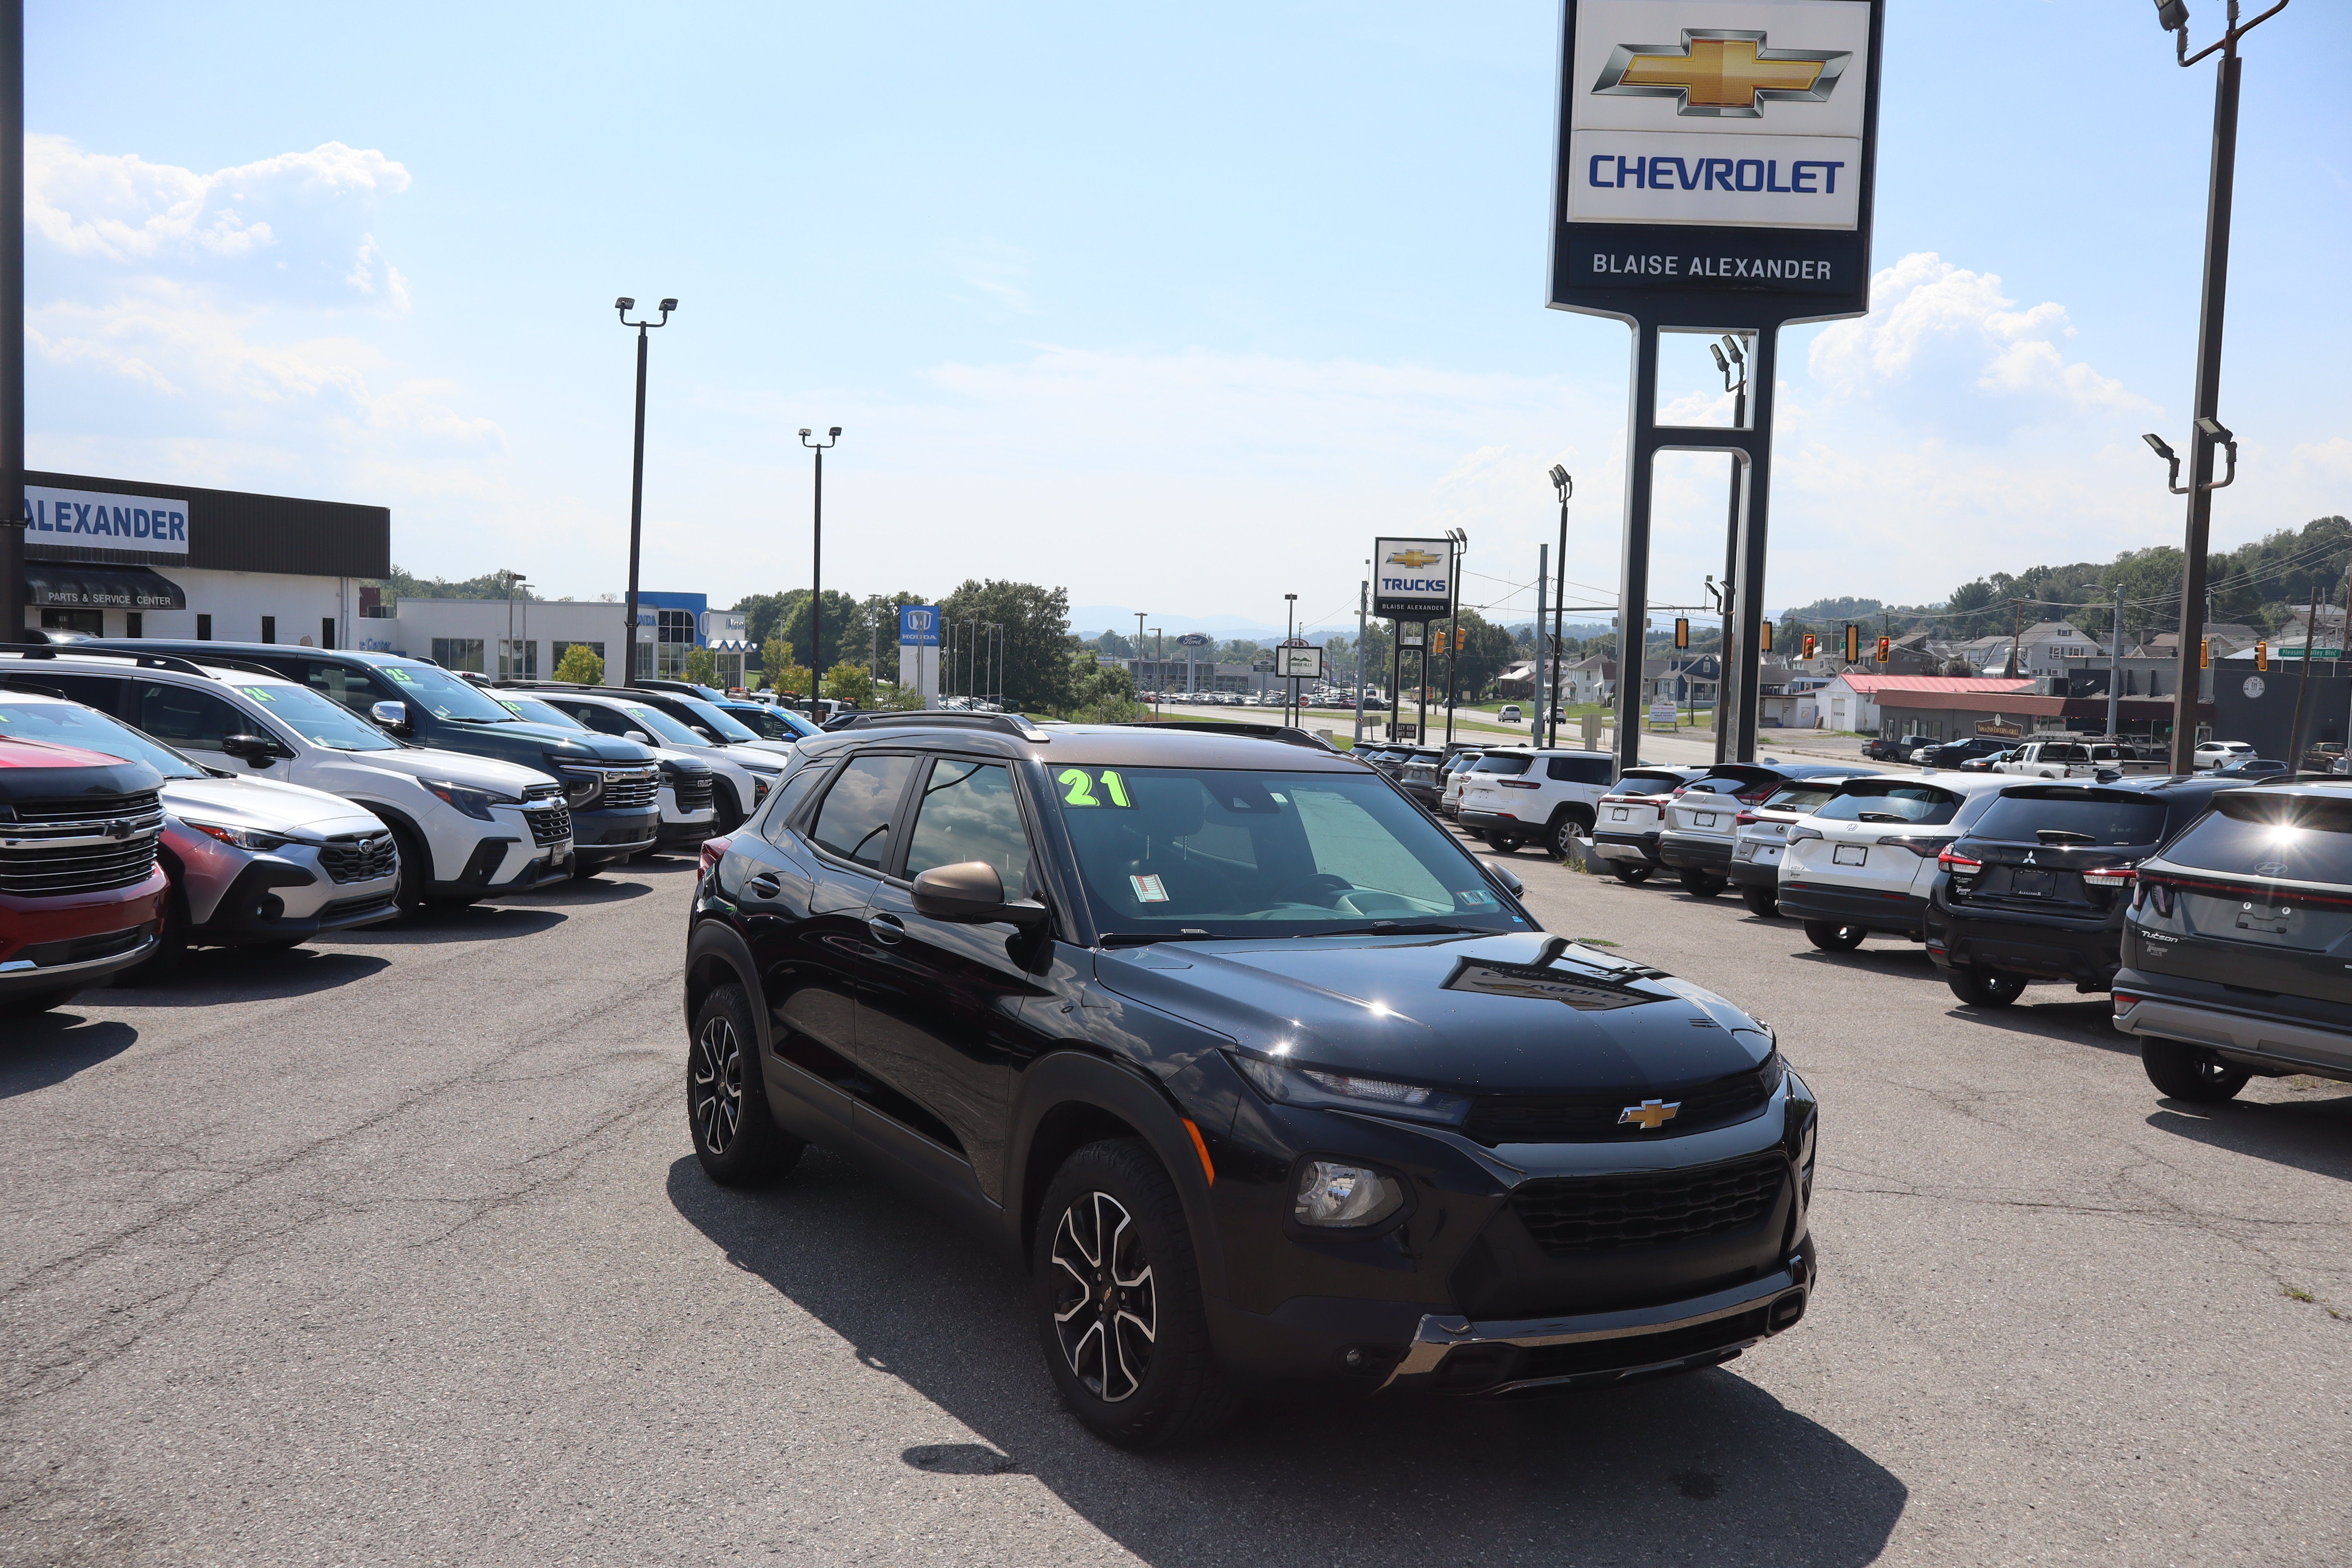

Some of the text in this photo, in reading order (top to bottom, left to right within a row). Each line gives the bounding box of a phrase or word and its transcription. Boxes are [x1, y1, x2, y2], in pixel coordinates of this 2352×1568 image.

[1589, 155, 1844, 193] CHEVROLET
[1593, 254, 1831, 280] BLAISE ALEXANDER
[1382, 578, 1446, 591] TRUCKS
[49, 592, 171, 605] PARTS & SERVICE CENTER
[386, 668, 412, 681] 25
[243, 687, 278, 702] 24
[1058, 768, 1131, 807] 21
[2141, 930, 2178, 943] Tucson
